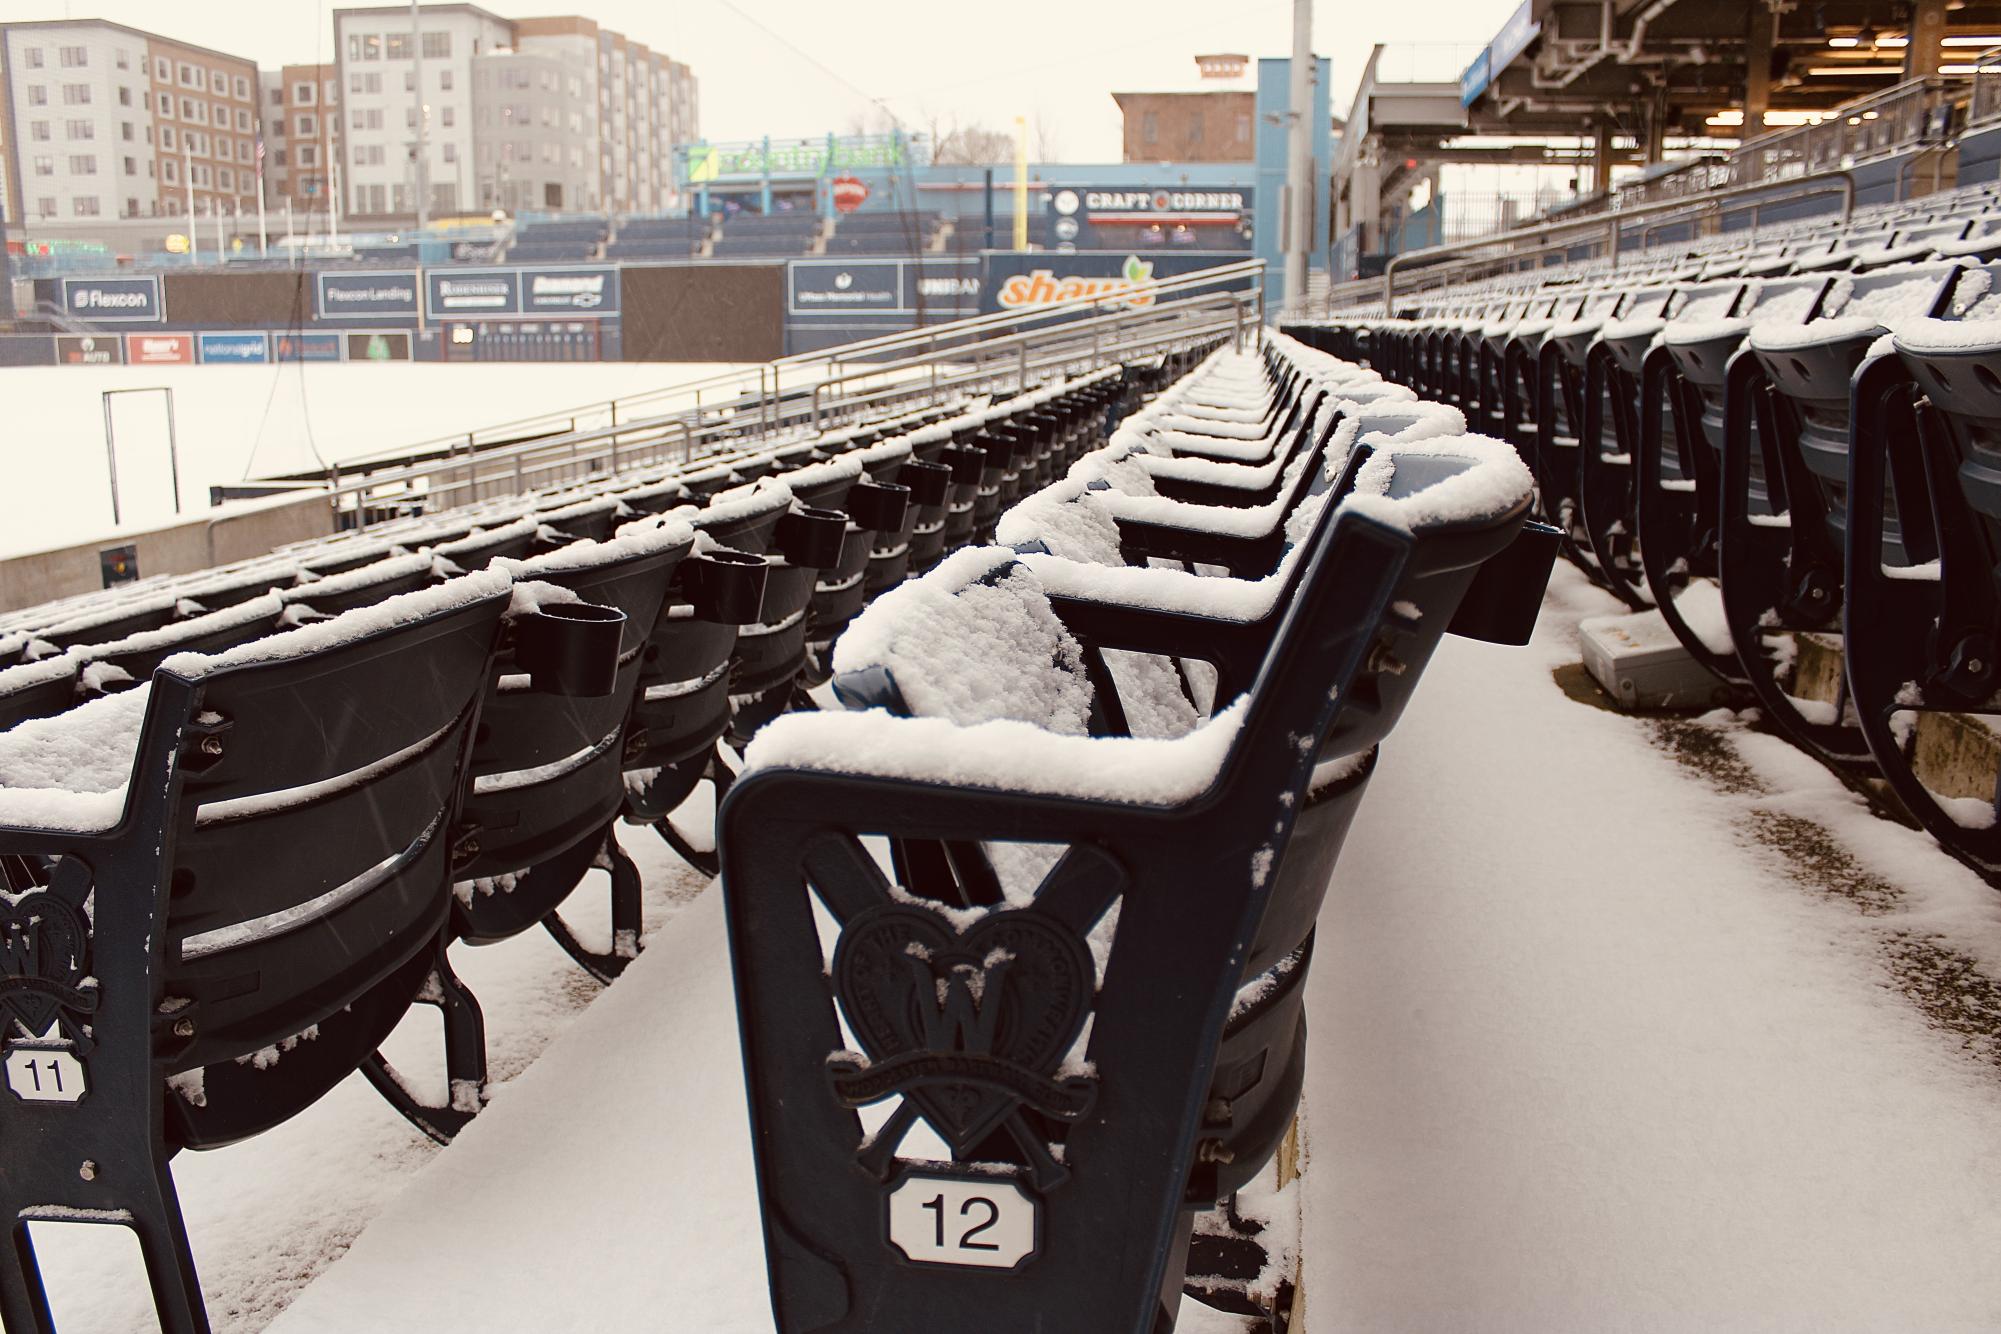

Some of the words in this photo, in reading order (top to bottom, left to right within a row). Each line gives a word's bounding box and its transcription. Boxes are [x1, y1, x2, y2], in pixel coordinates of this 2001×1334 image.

[1086, 192, 1150, 210] CRAFT
[1170, 192, 1243, 210] CORNER
[90, 289, 148, 308] Flexcon
[25, 1059, 63, 1092] 11
[922, 1194, 999, 1251] 12
